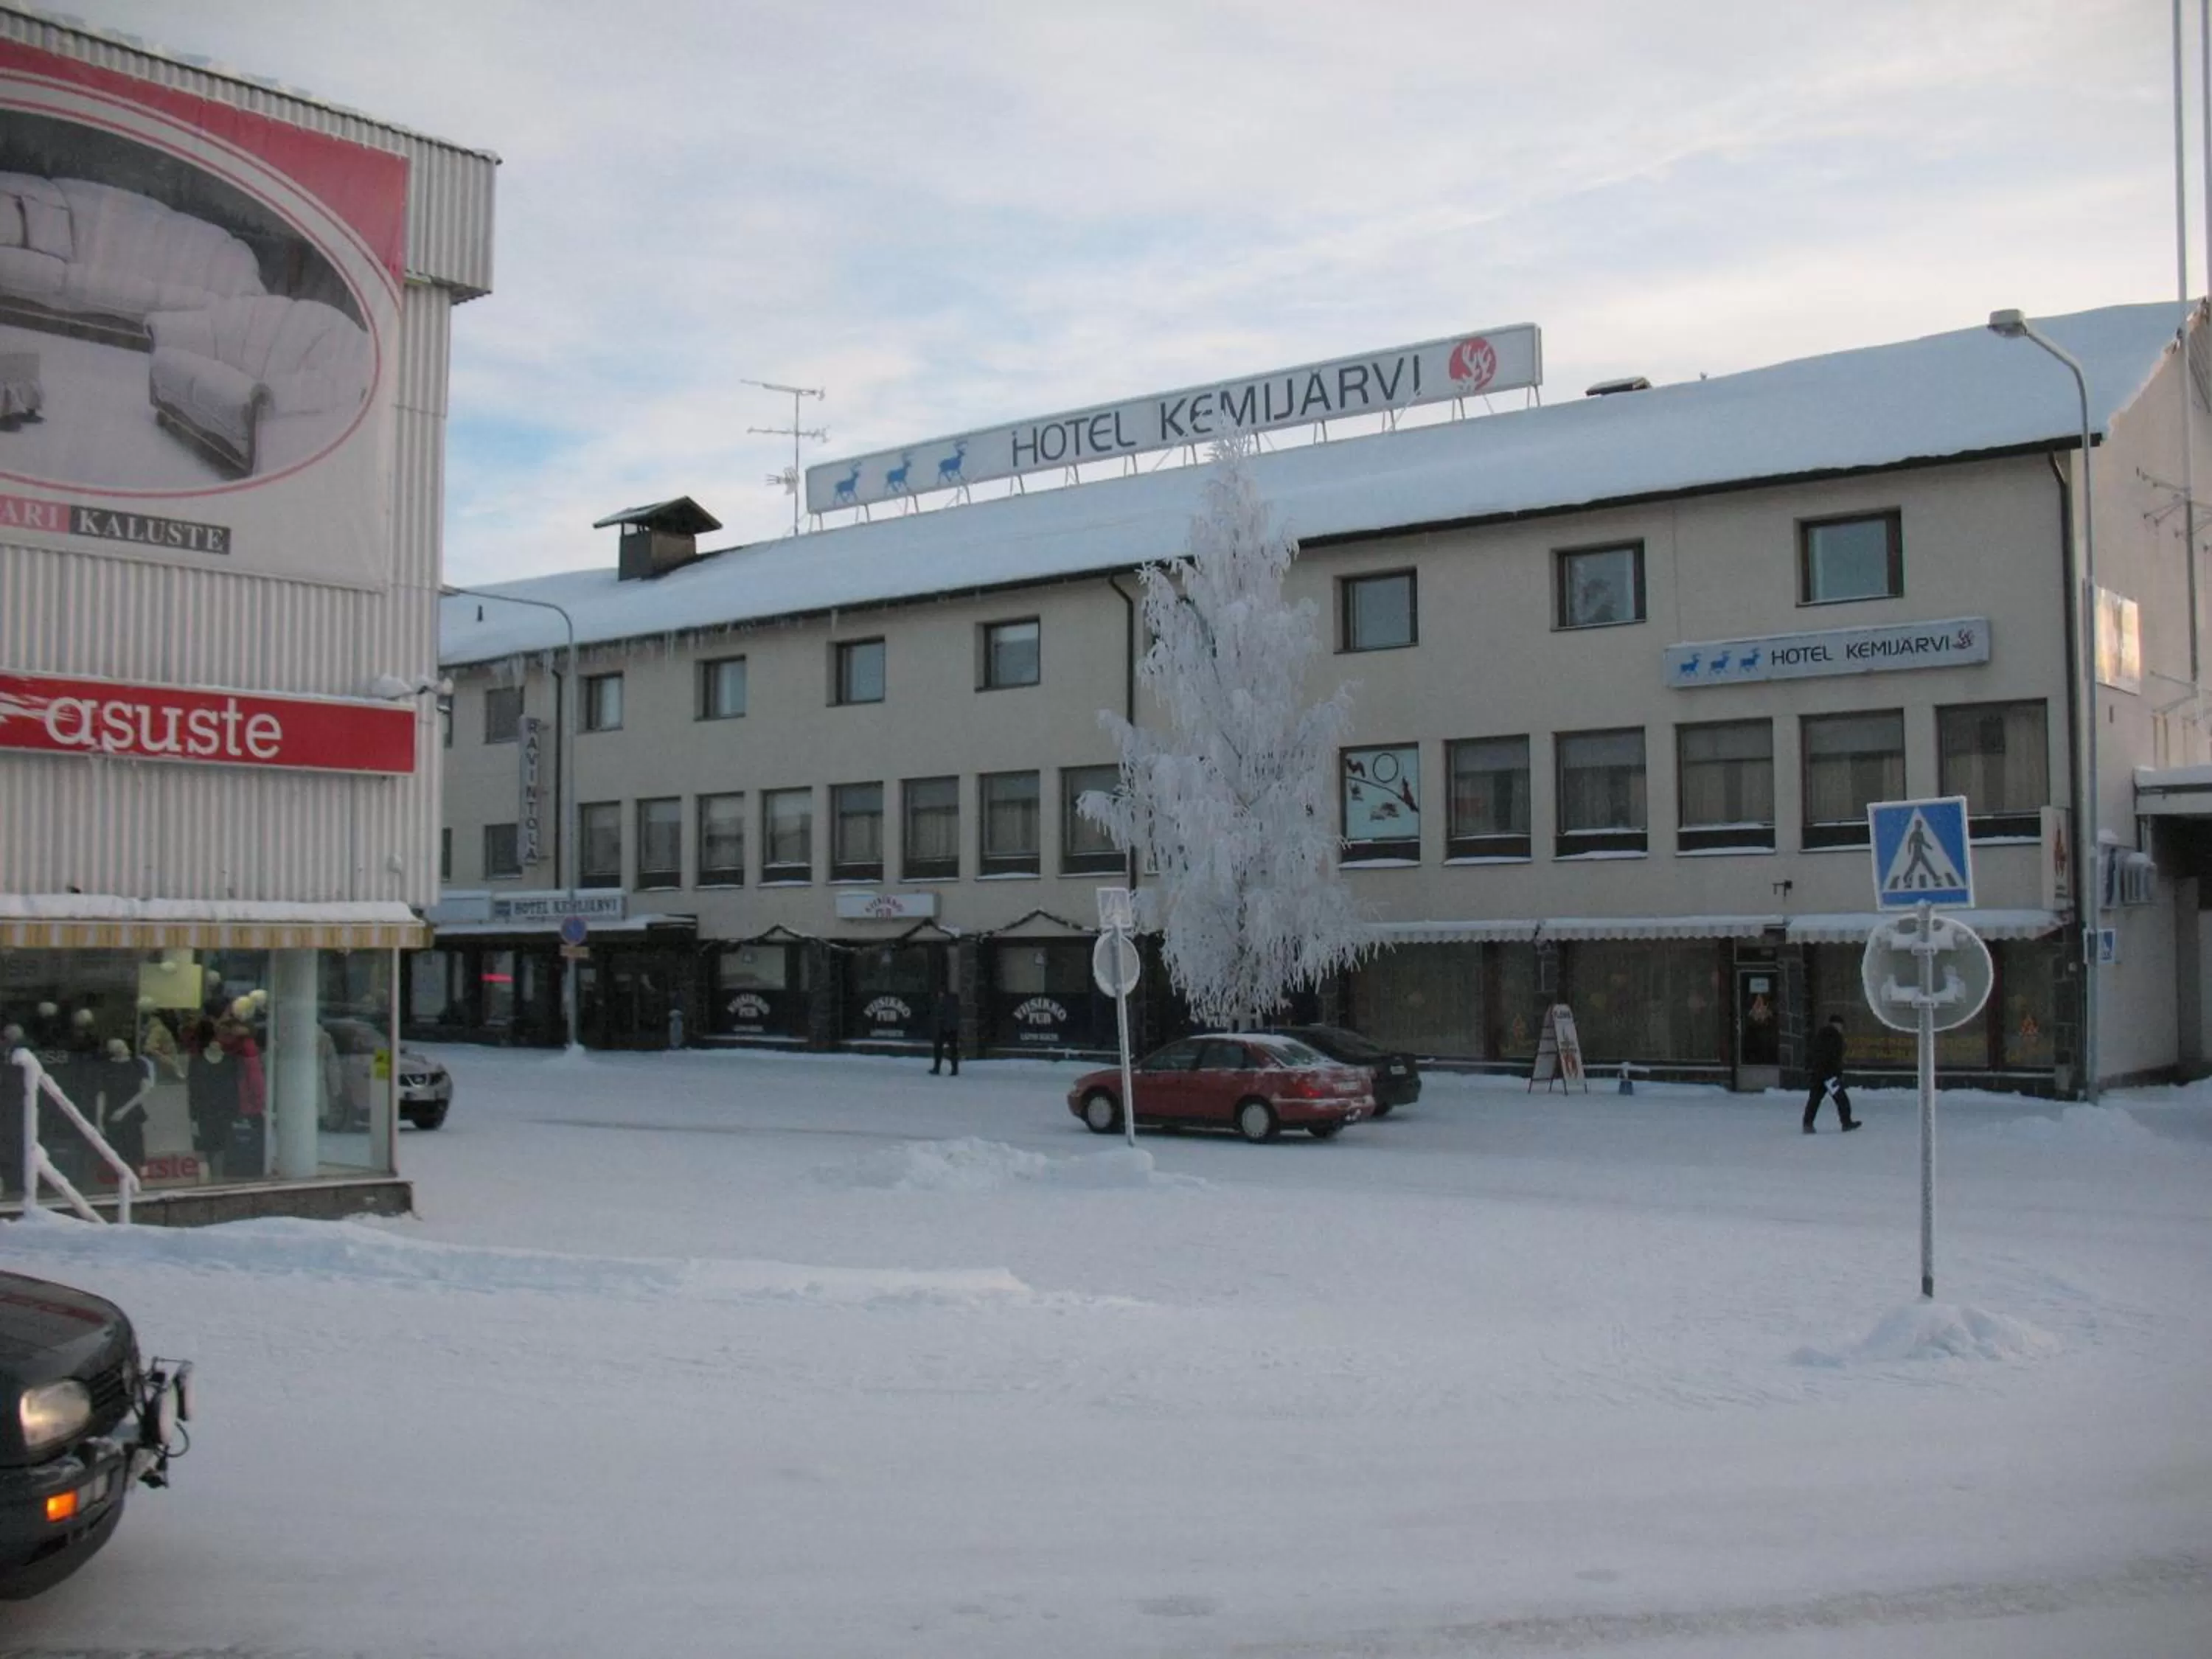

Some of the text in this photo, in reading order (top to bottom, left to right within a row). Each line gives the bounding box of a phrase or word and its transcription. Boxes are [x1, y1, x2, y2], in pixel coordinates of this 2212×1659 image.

[1011, 410, 1138, 468] HOTEL
[77, 508, 226, 552] KALUSTE
[1771, 645, 1834, 666] HOTEL
[45, 696, 283, 759] asuste
